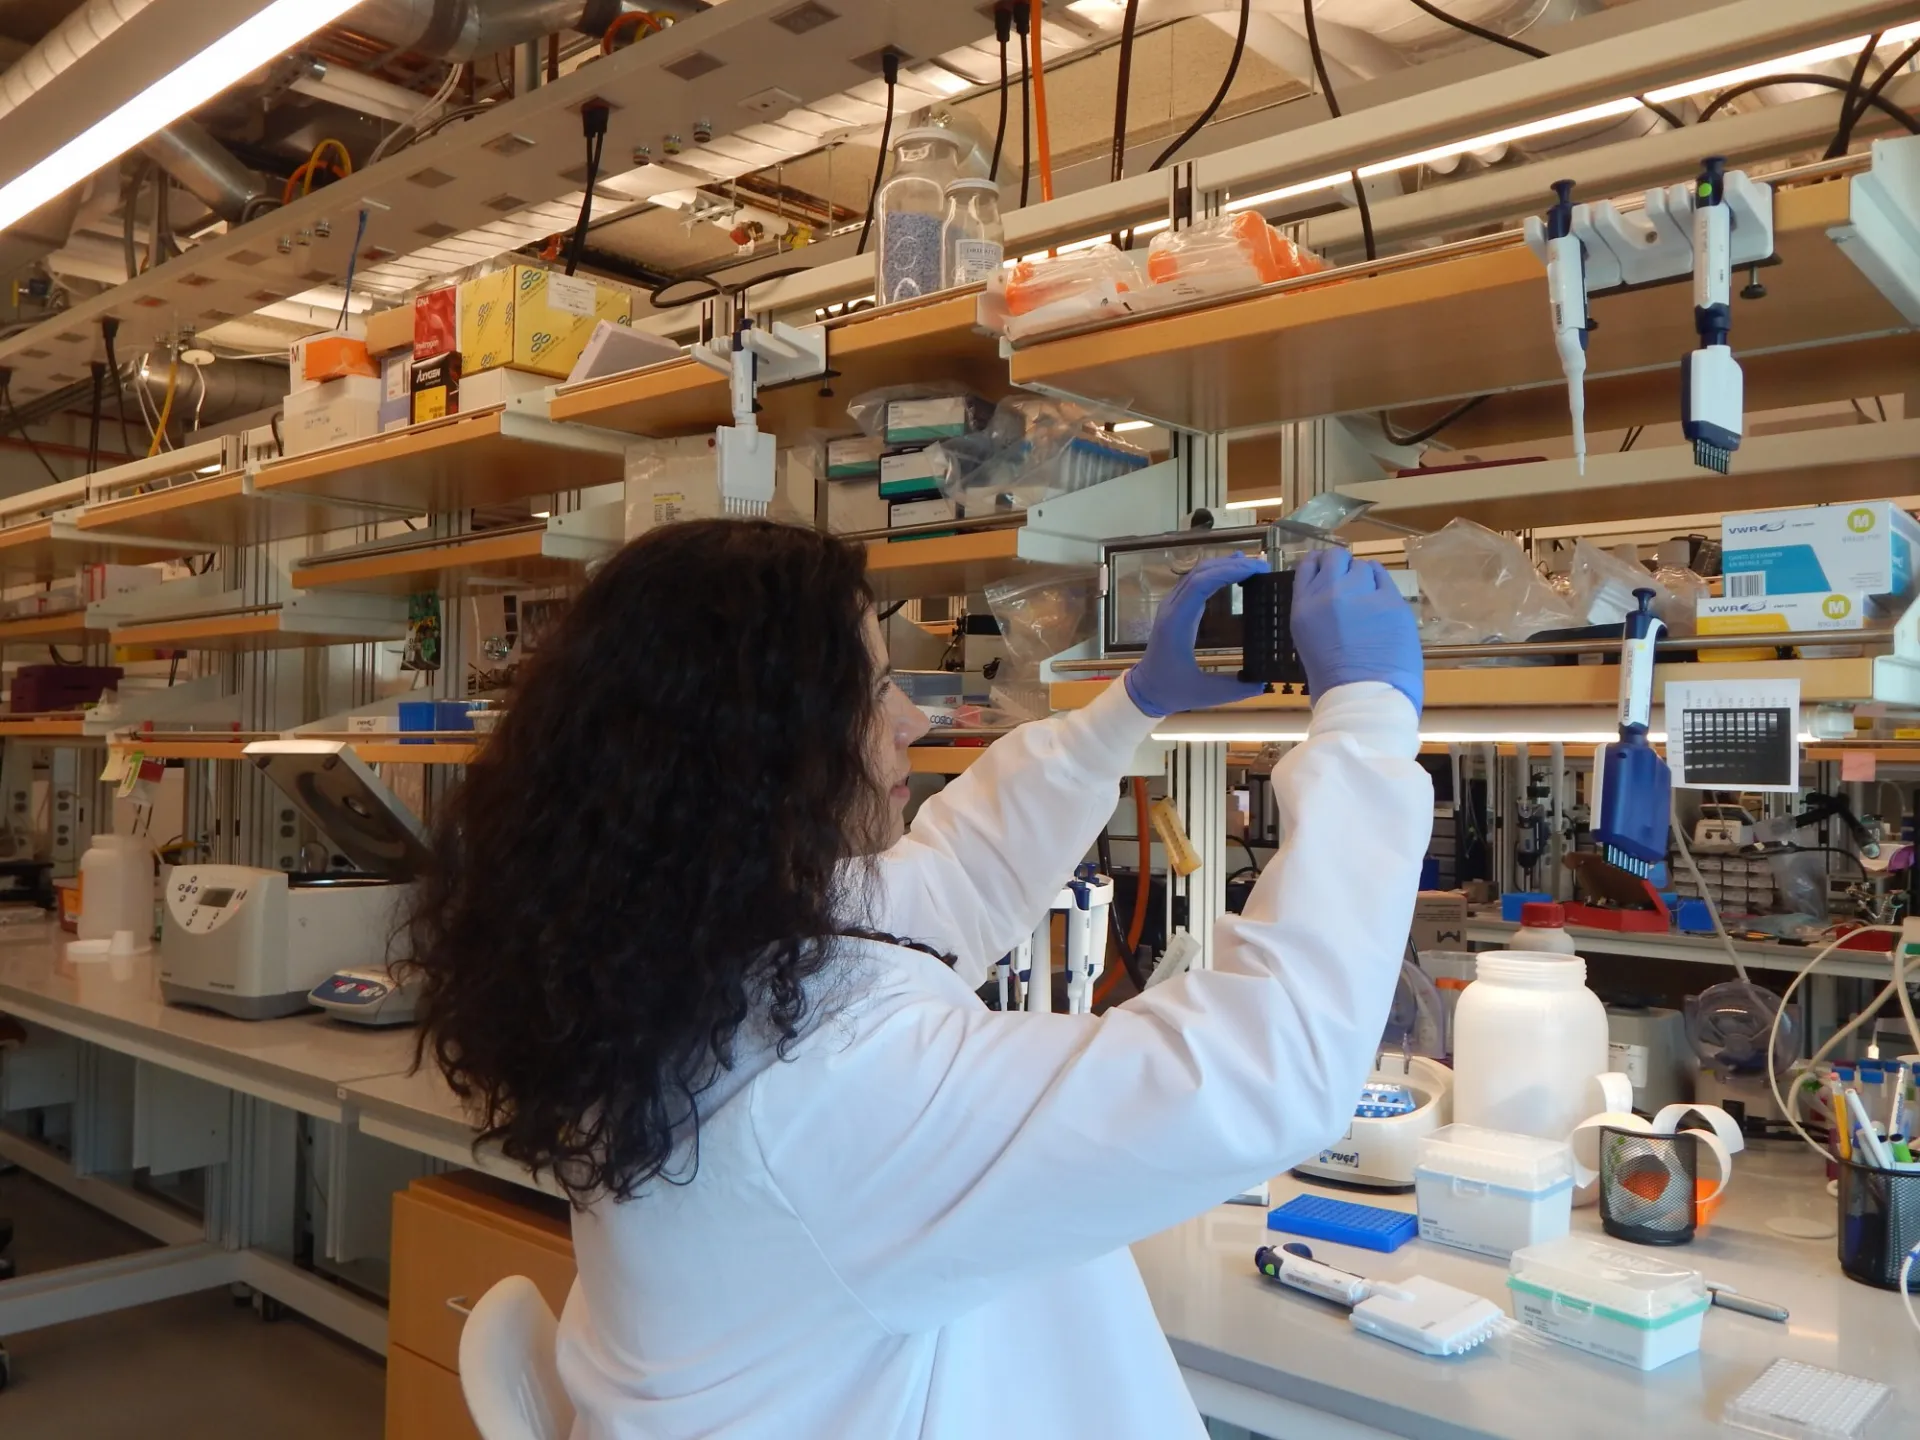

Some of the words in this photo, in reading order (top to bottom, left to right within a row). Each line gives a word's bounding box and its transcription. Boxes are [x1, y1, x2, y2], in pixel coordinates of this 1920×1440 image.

[1853, 514, 1869, 528] M
[1728, 525, 1758, 535] VWR
[1708, 605, 1739, 613] VWR
[1828, 600, 1845, 615] M
